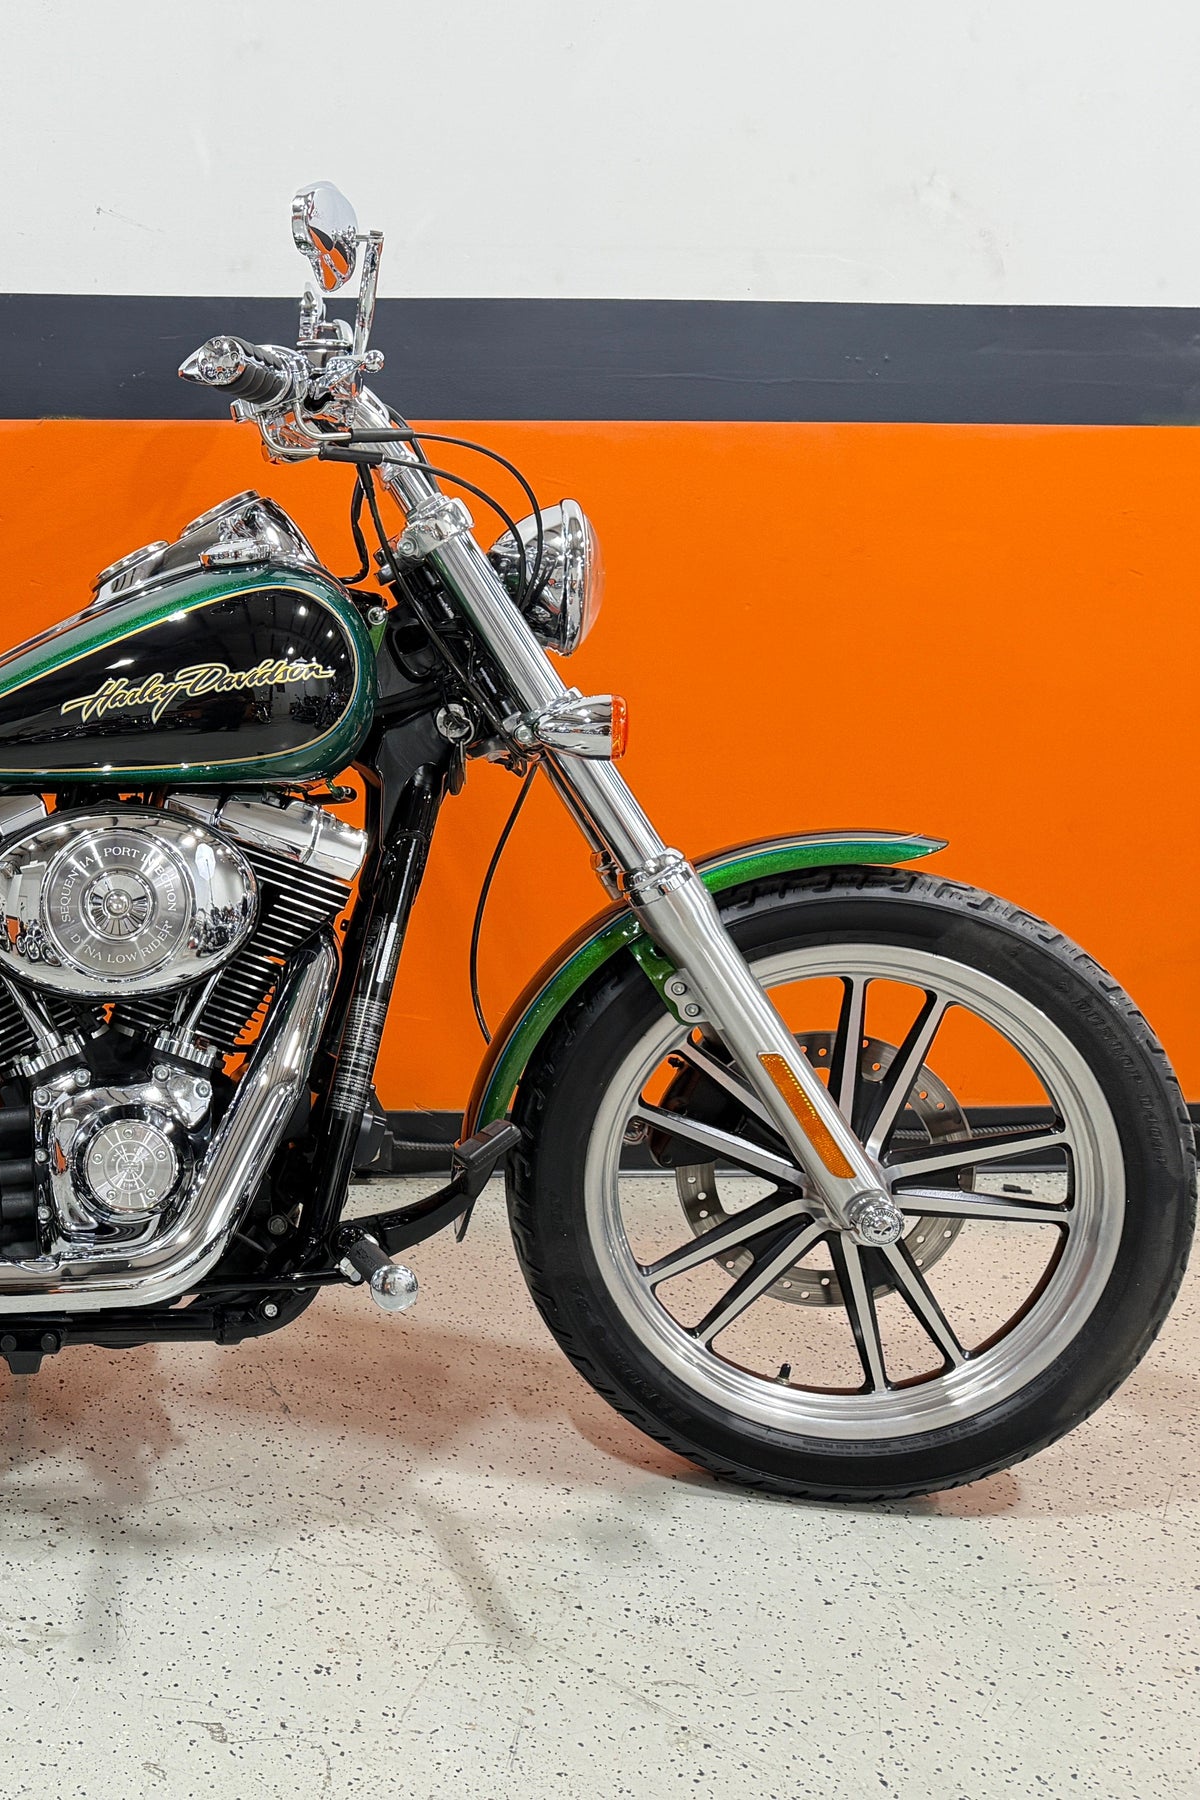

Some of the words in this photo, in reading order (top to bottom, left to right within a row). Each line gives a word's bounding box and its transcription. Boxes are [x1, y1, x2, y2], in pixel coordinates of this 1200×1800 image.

[61, 659, 336, 724] Harley-Davidson
[103, 846, 140, 858] PORT
[140, 853, 177, 911] INECTION
[107, 952, 137, 963] LOW
